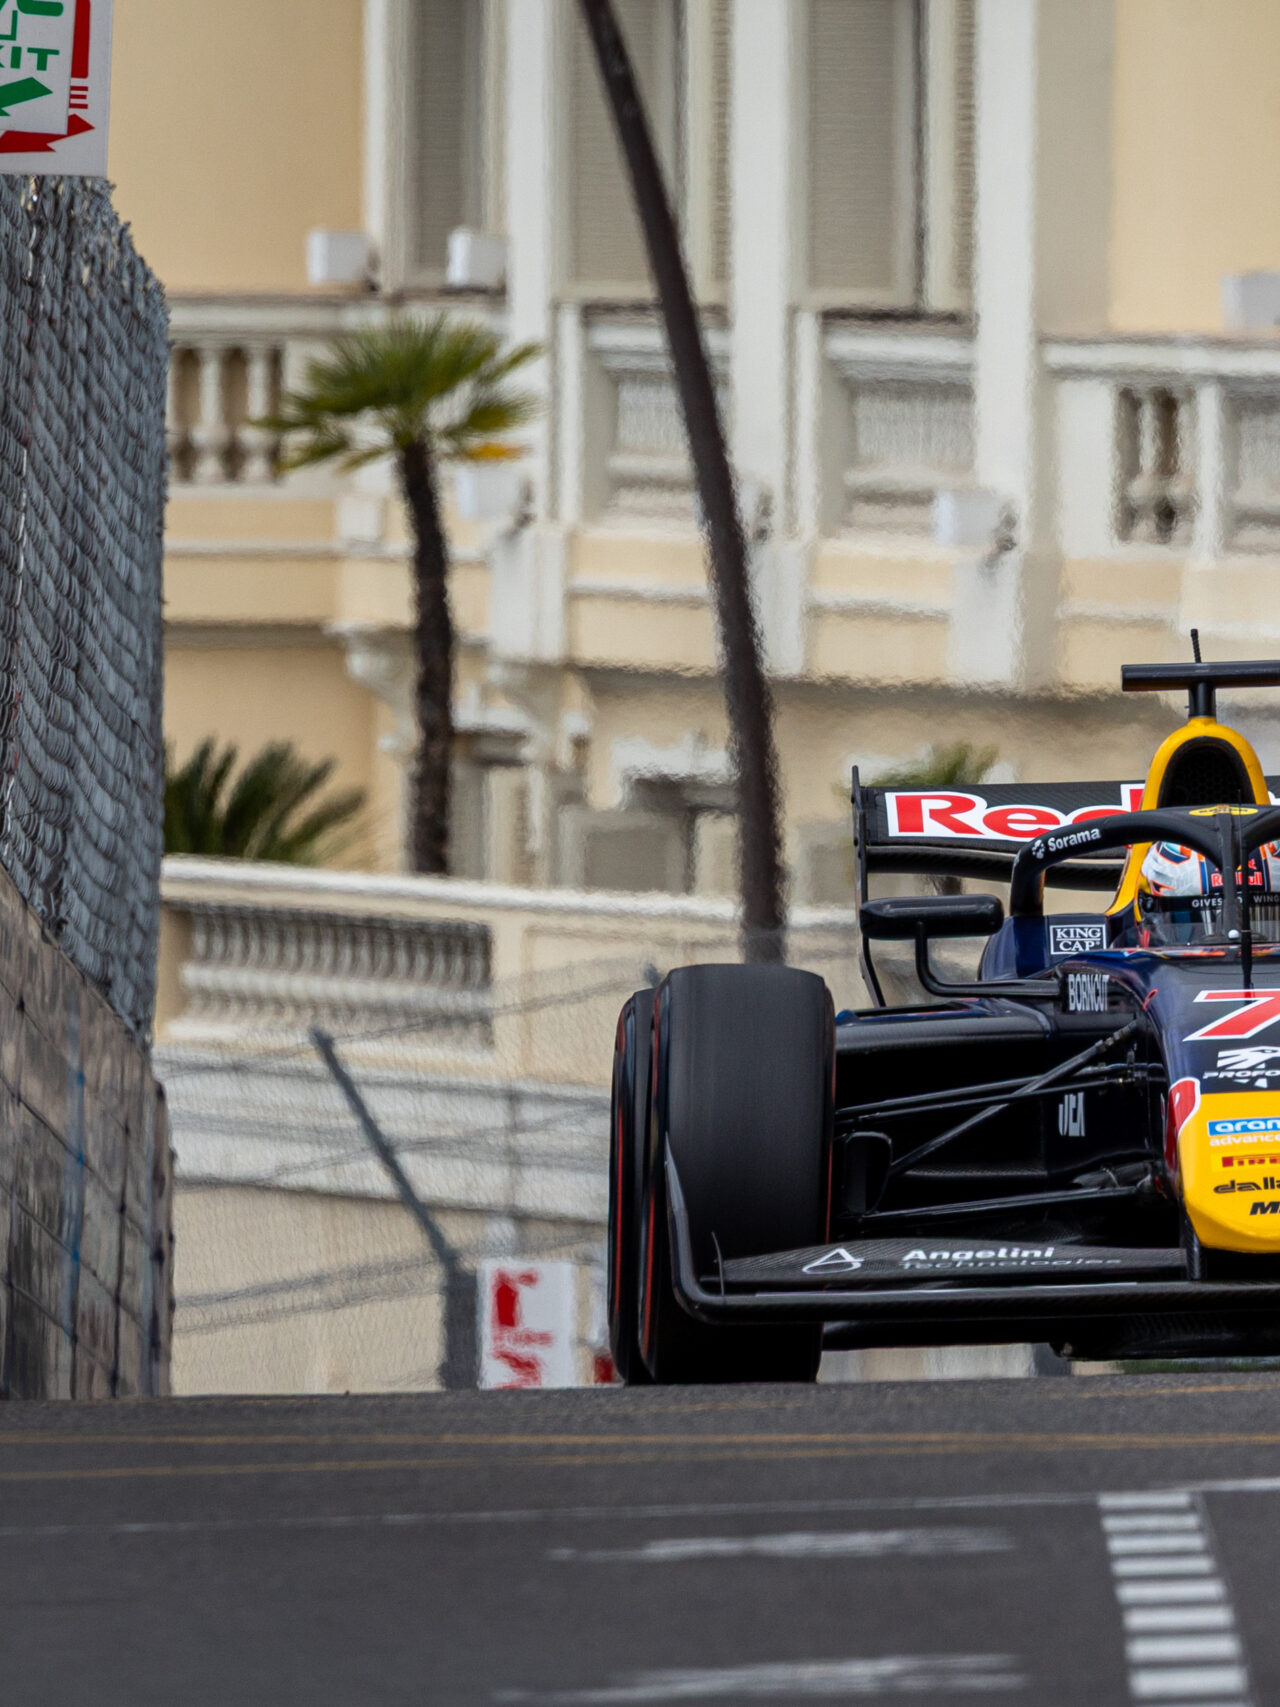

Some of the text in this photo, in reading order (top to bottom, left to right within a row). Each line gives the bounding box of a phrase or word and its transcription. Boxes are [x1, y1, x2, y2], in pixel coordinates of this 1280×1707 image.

[0, 45, 60, 71] IT
[1048, 828, 1100, 850] Sorama
[1191, 898, 1223, 908] GIVES
[1056, 928, 1101, 939] KING
[901, 1246, 1055, 1261] Angelini
[898, 1257, 1122, 1270] Technologies
